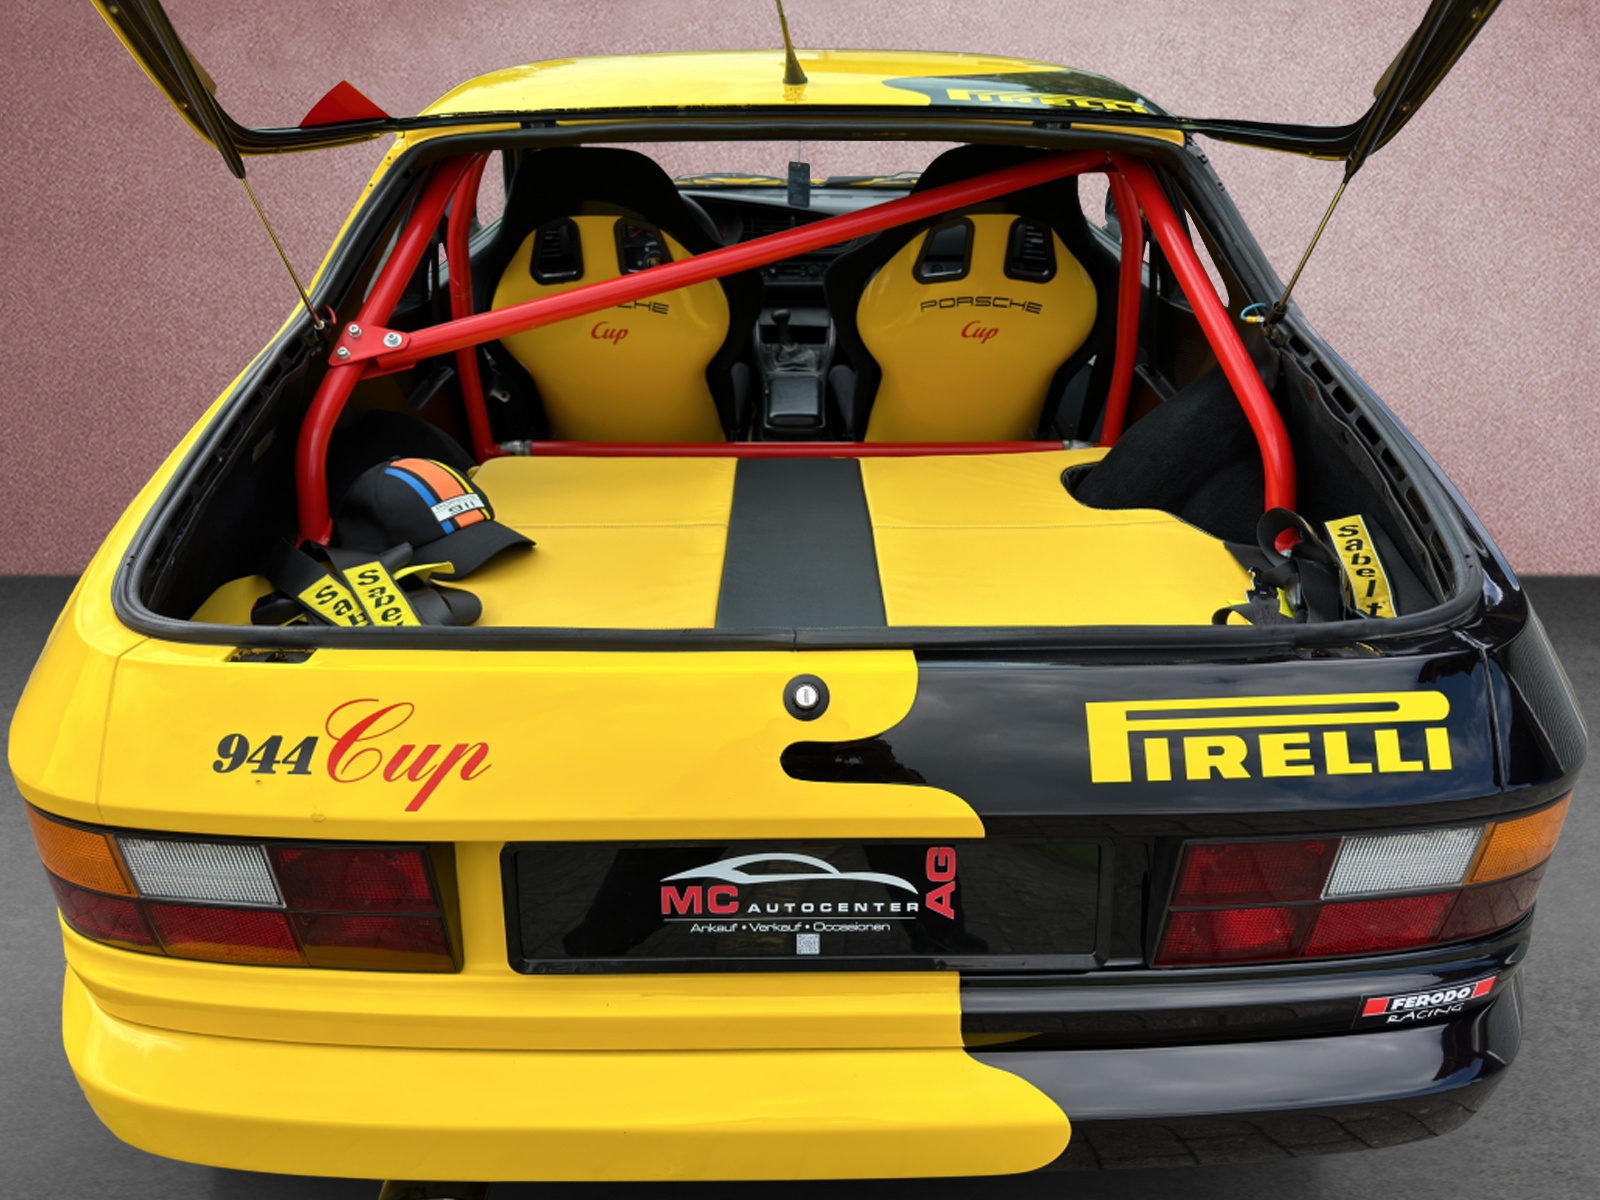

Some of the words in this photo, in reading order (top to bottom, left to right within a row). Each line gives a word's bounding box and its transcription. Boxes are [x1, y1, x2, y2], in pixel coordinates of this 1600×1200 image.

[920, 296, 1043, 315] PORSCHE
[590, 321, 629, 346] Cup
[960, 320, 999, 344] Cup
[1337, 524, 1384, 618] Sabelt
[1085, 690, 1453, 784] PIRELLI
[212, 733, 319, 775] 944
[325, 698, 492, 812] Cup
[925, 846, 957, 919] AG
[661, 886, 739, 914] MC
[748, 902, 919, 913] AUTOCENTER
[690, 922, 738, 933] Ankauf
[749, 922, 803, 933] Verkauf
[813, 921, 891, 933] Occasionen
[1391, 987, 1471, 1010] FERODO
[1386, 1002, 1465, 1024] RACING
